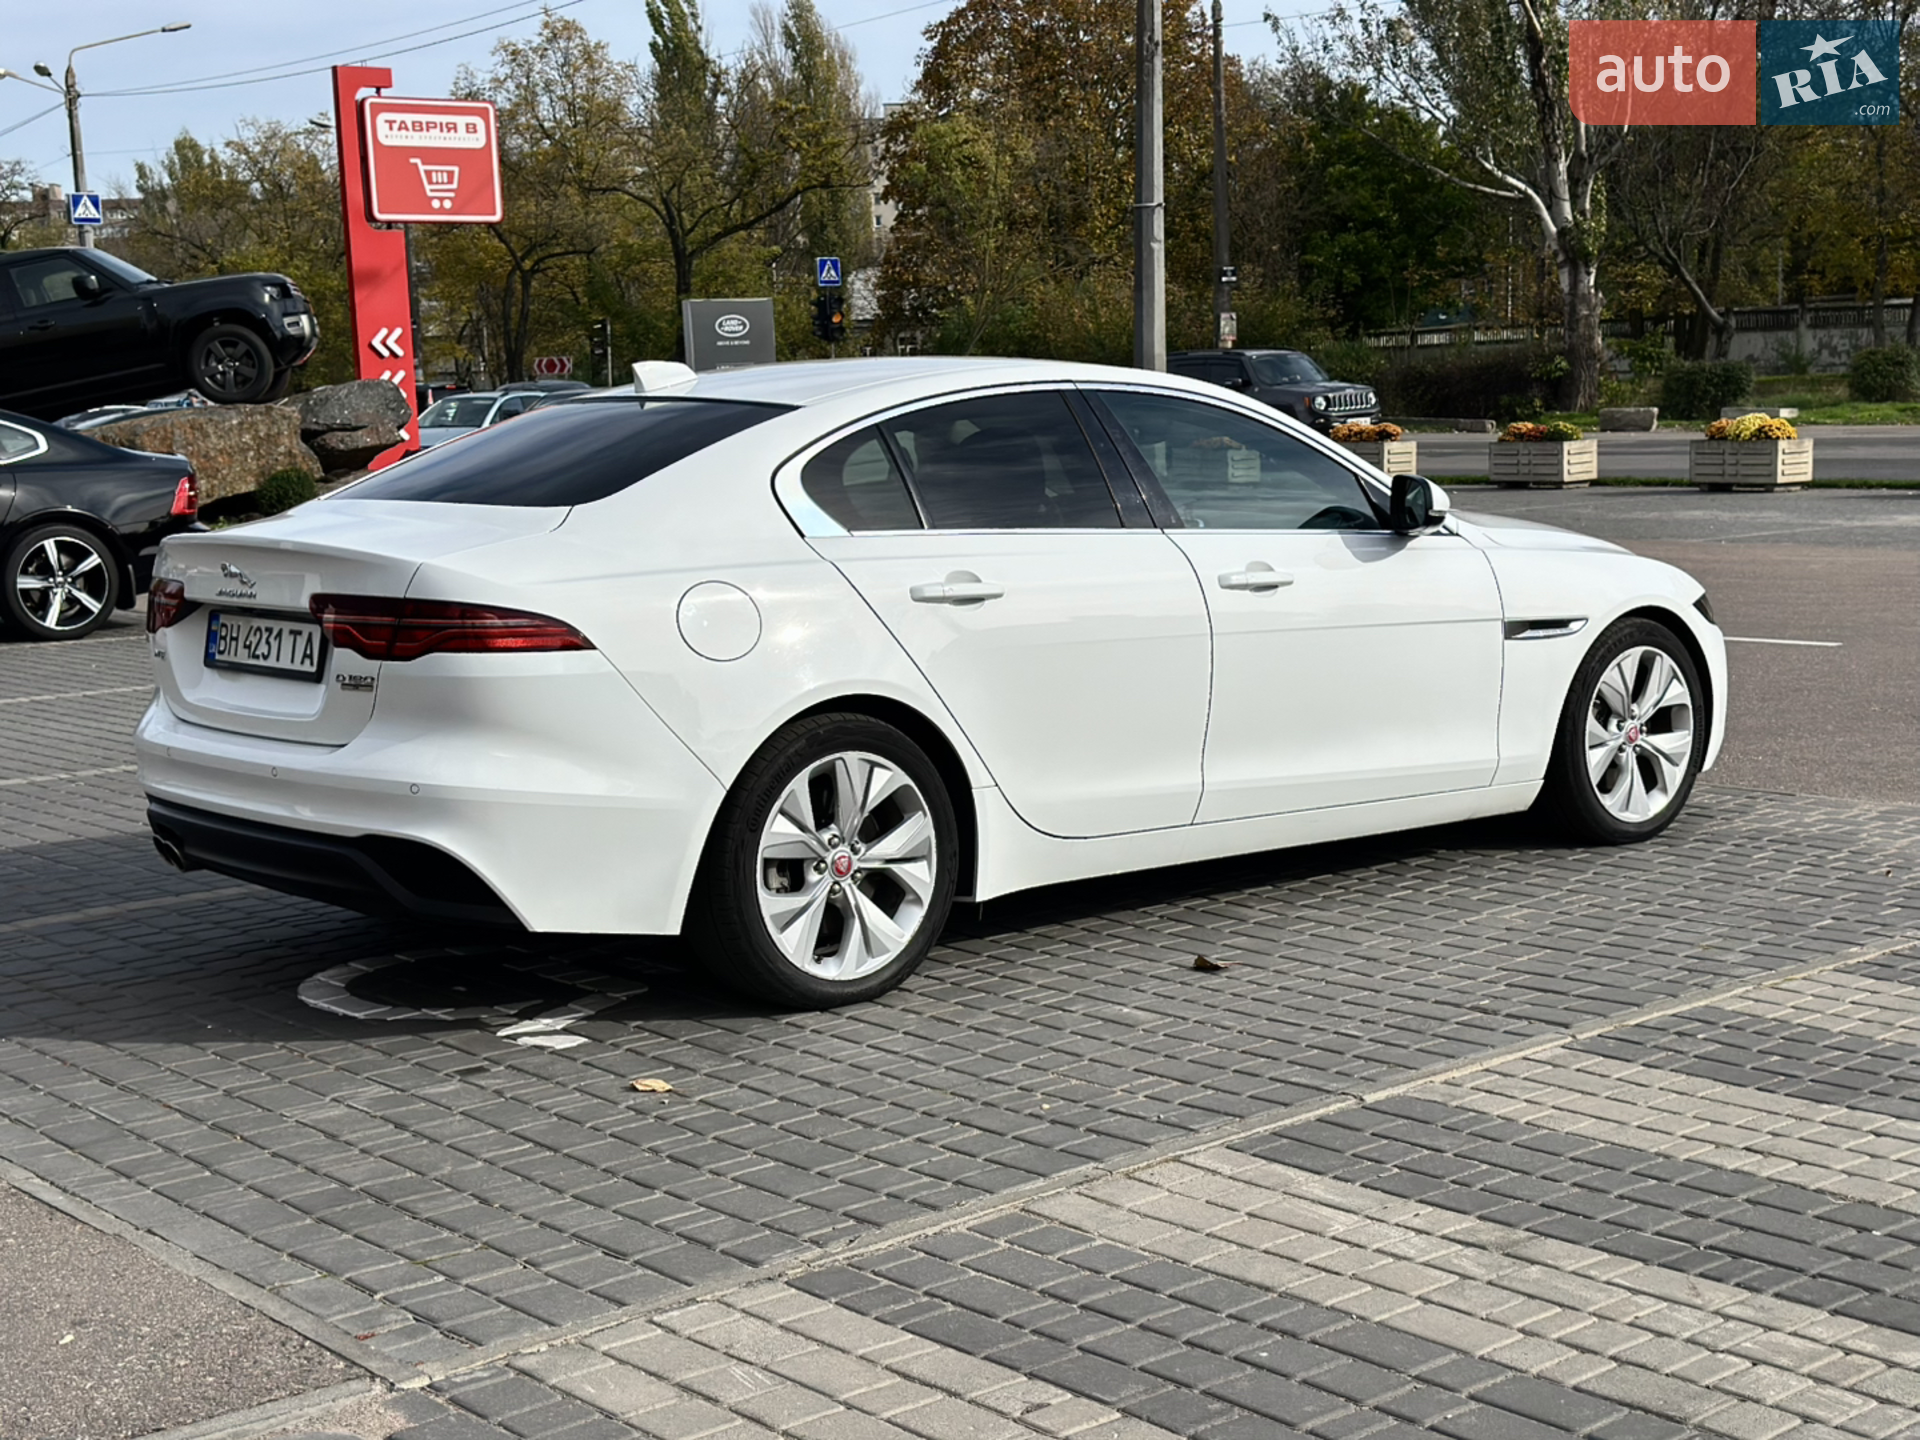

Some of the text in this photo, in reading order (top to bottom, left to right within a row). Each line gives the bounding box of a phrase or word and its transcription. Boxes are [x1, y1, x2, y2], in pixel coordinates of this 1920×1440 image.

[384, 119, 478, 134] ТАВРІЯ В
[215, 587, 257, 599] JAGUAR
[217, 622, 314, 667] BH 4231 TA
[746, 757, 796, 833] Continental
